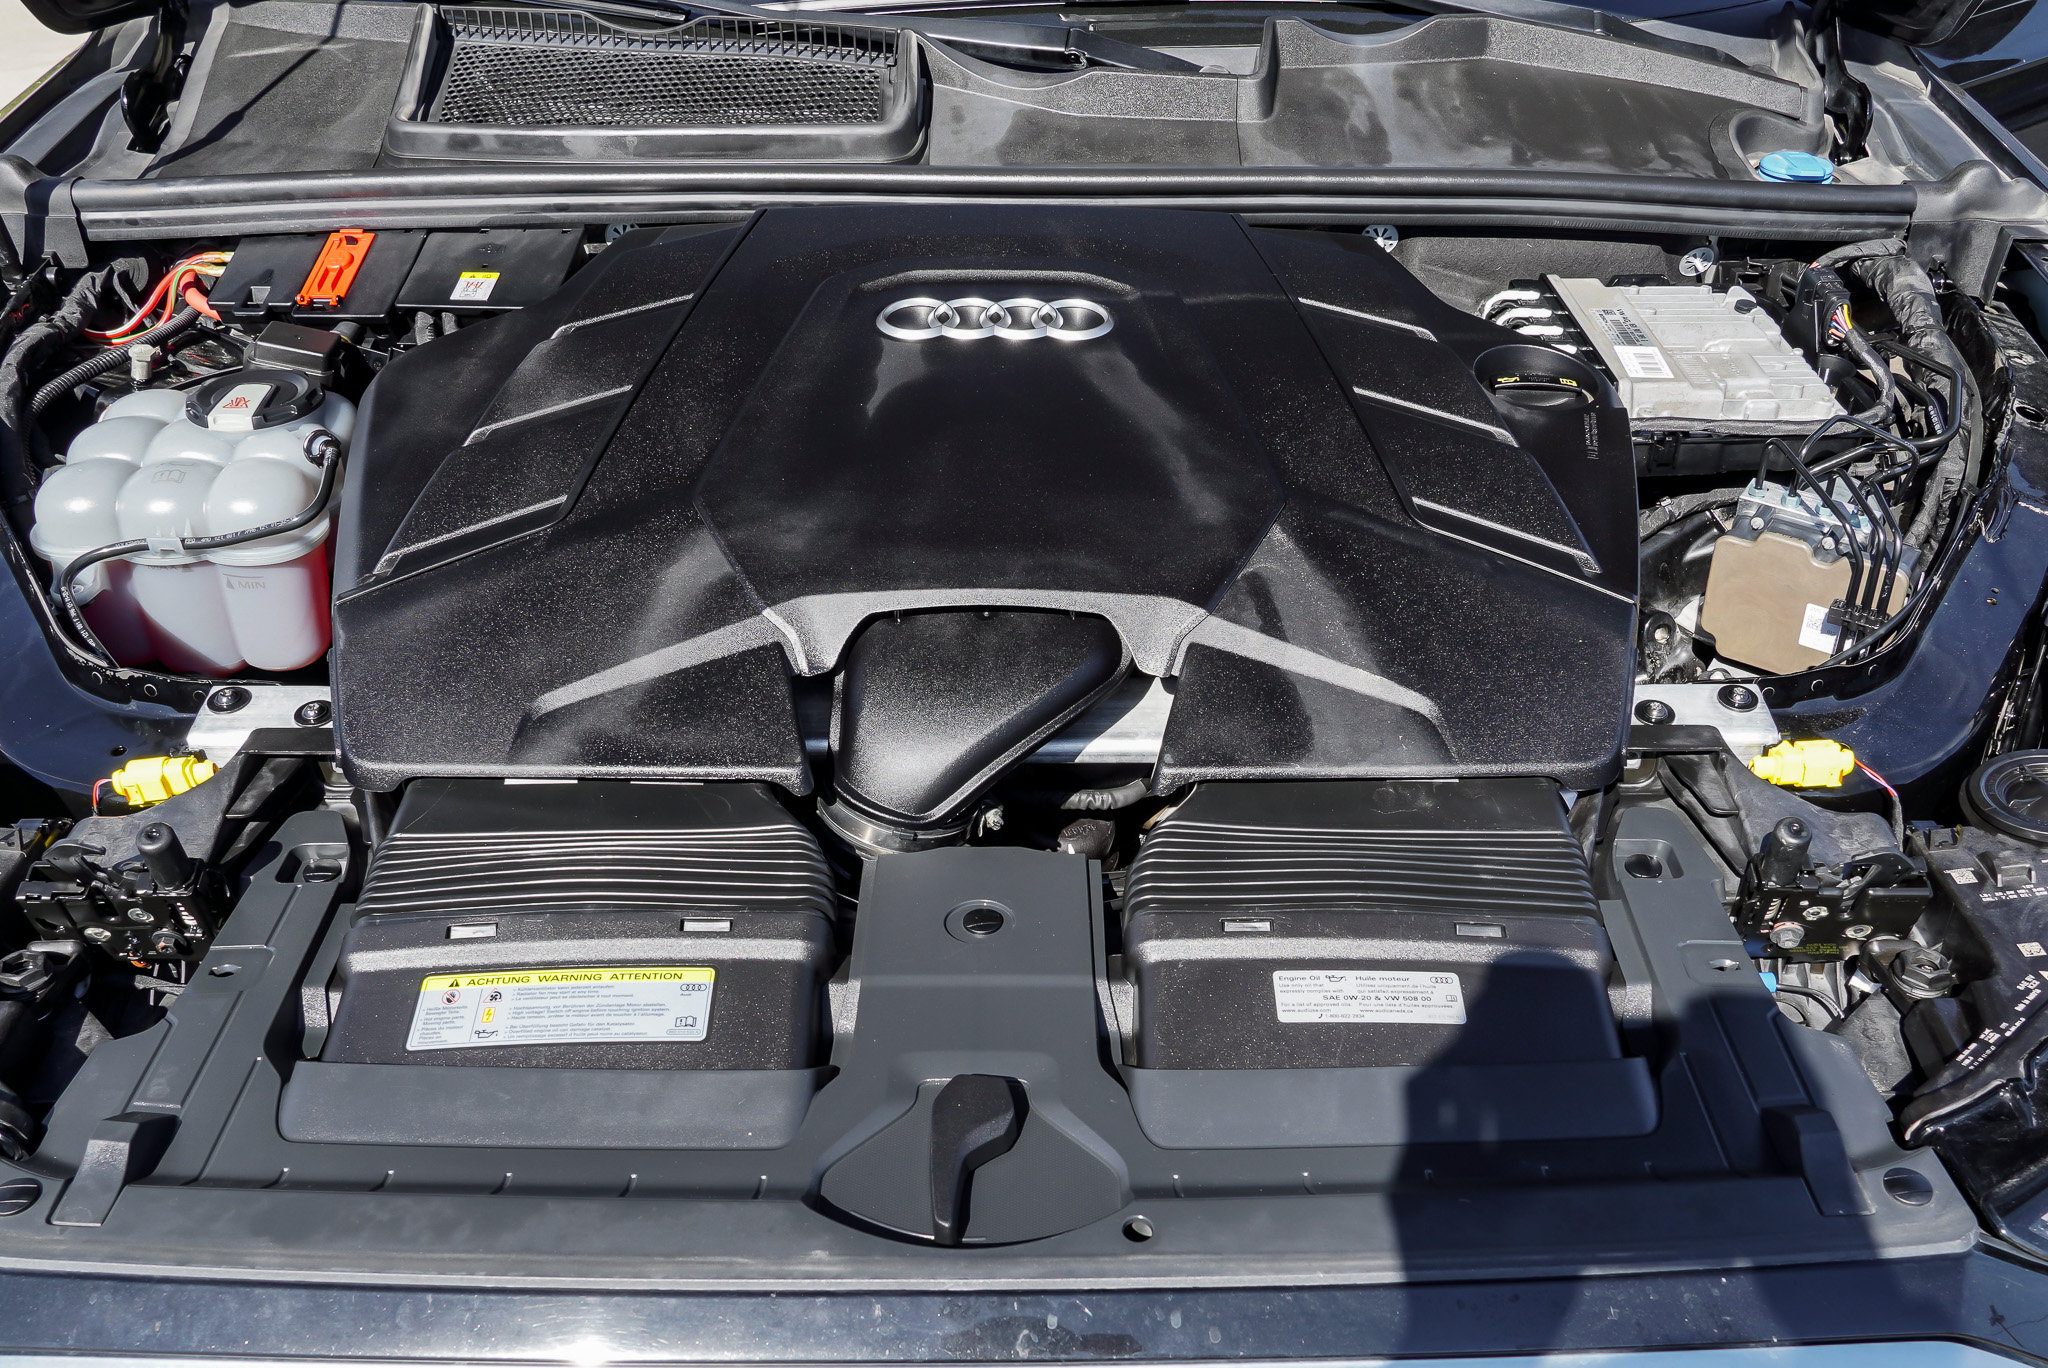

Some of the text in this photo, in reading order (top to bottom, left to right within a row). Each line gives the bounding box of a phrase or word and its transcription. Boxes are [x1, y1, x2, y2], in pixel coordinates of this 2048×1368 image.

[238, 580, 266, 590] MIN
[467, 972, 683, 986] ACHTUNG WARNING ATTENTION
